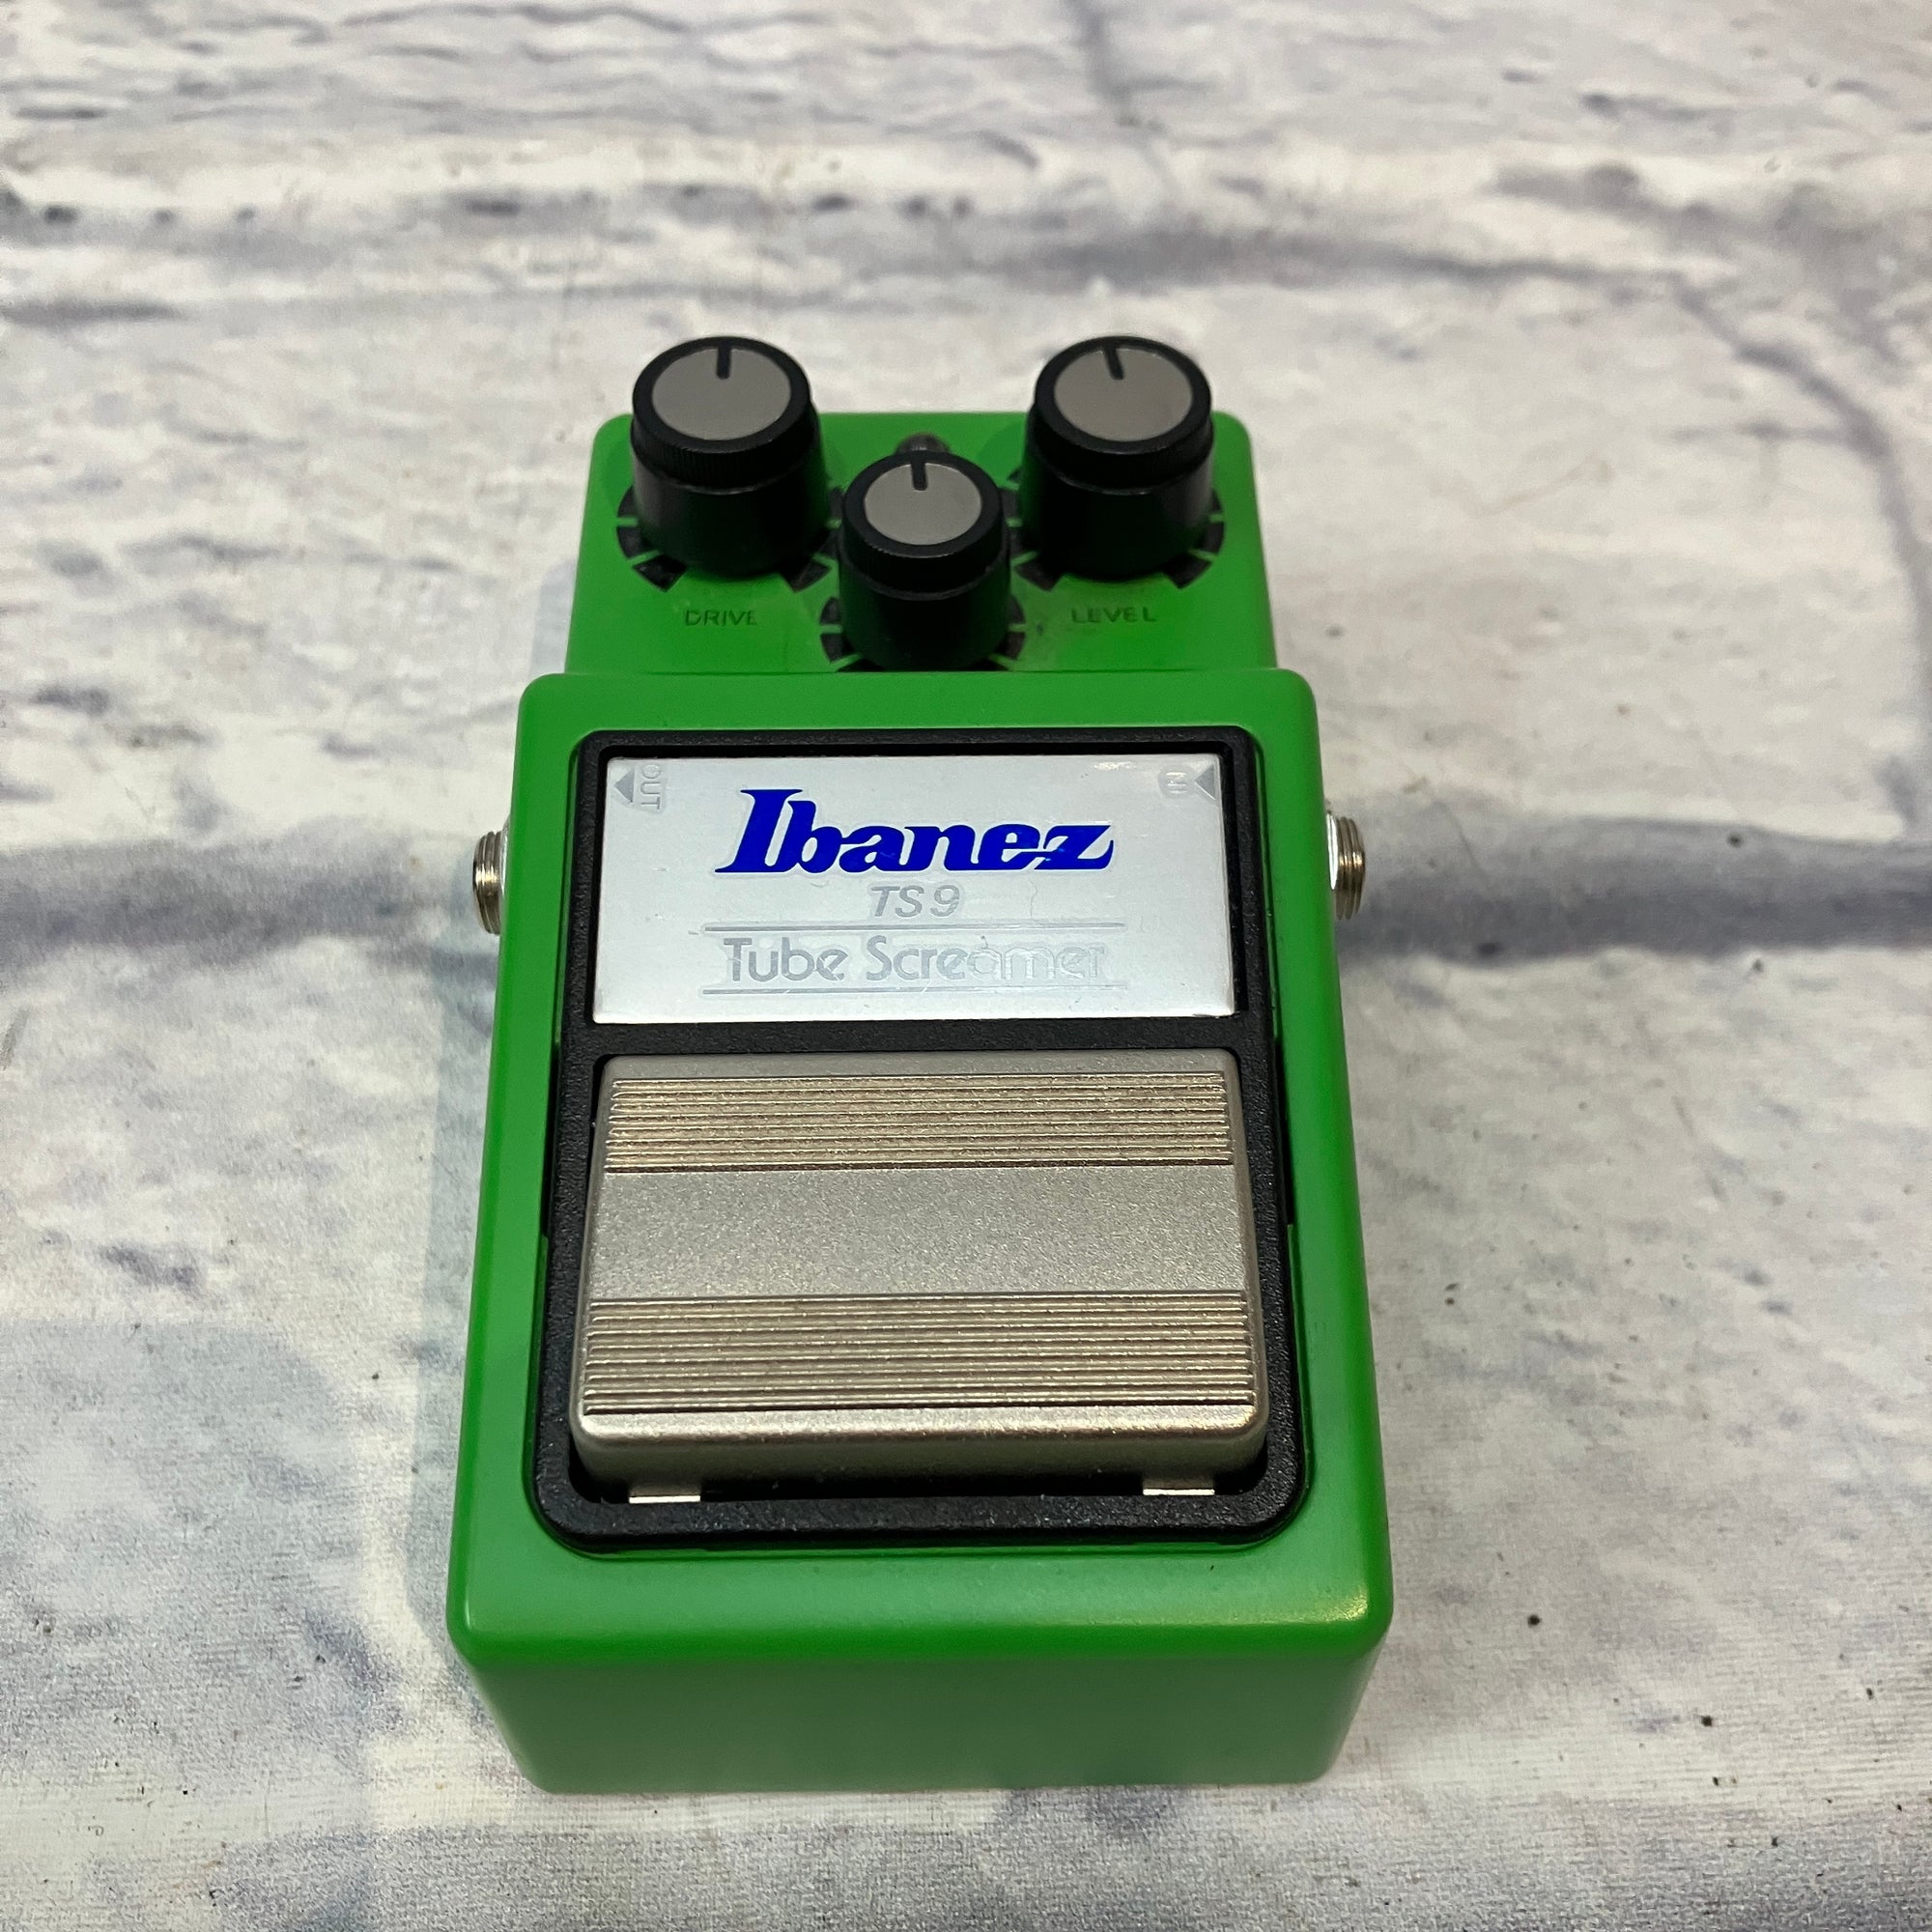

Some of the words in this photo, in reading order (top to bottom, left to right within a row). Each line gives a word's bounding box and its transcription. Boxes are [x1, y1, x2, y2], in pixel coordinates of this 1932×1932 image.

[685, 610, 757, 626] DRIVE
[1070, 606, 1158, 623] LEVEL
[640, 764, 662, 810] OUT
[715, 788, 1115, 873] Ibanez
[724, 937, 849, 982] Tube
[867, 934, 1105, 981] Screamer
